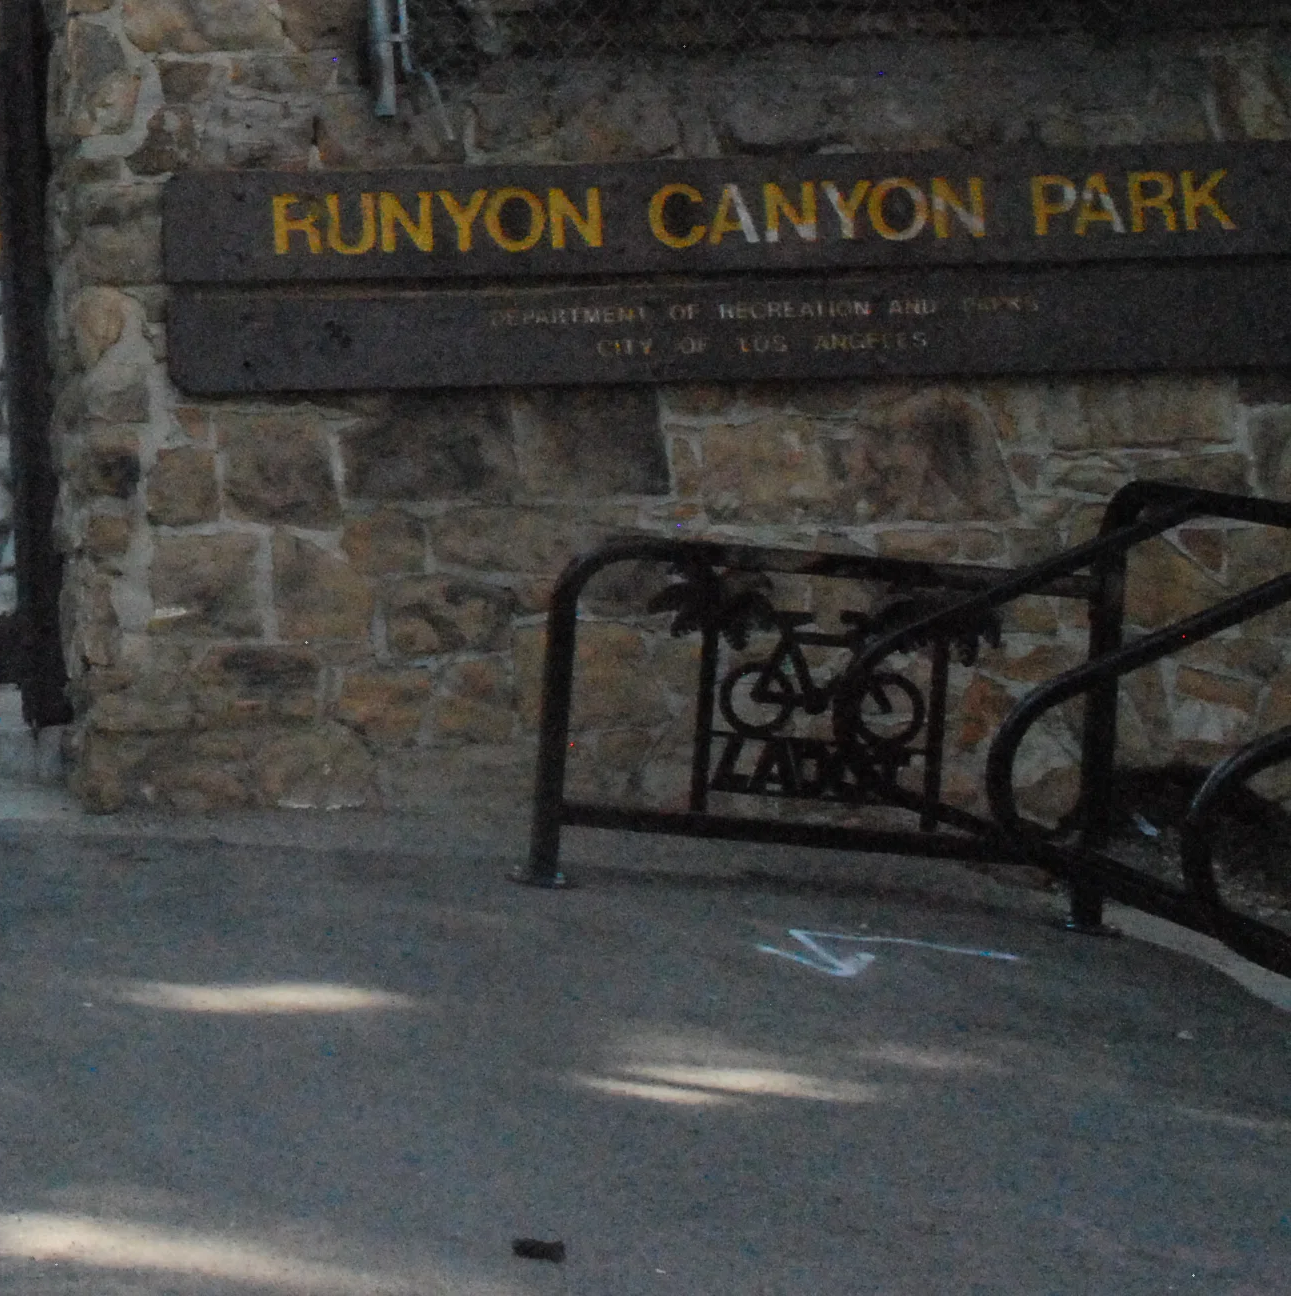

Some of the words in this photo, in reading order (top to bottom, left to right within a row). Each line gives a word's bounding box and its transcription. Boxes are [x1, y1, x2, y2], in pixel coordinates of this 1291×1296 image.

[271, 186, 604, 255] RUNYON
[648, 174, 986, 250] CANYON
[1029, 168, 1237, 237] PARK
